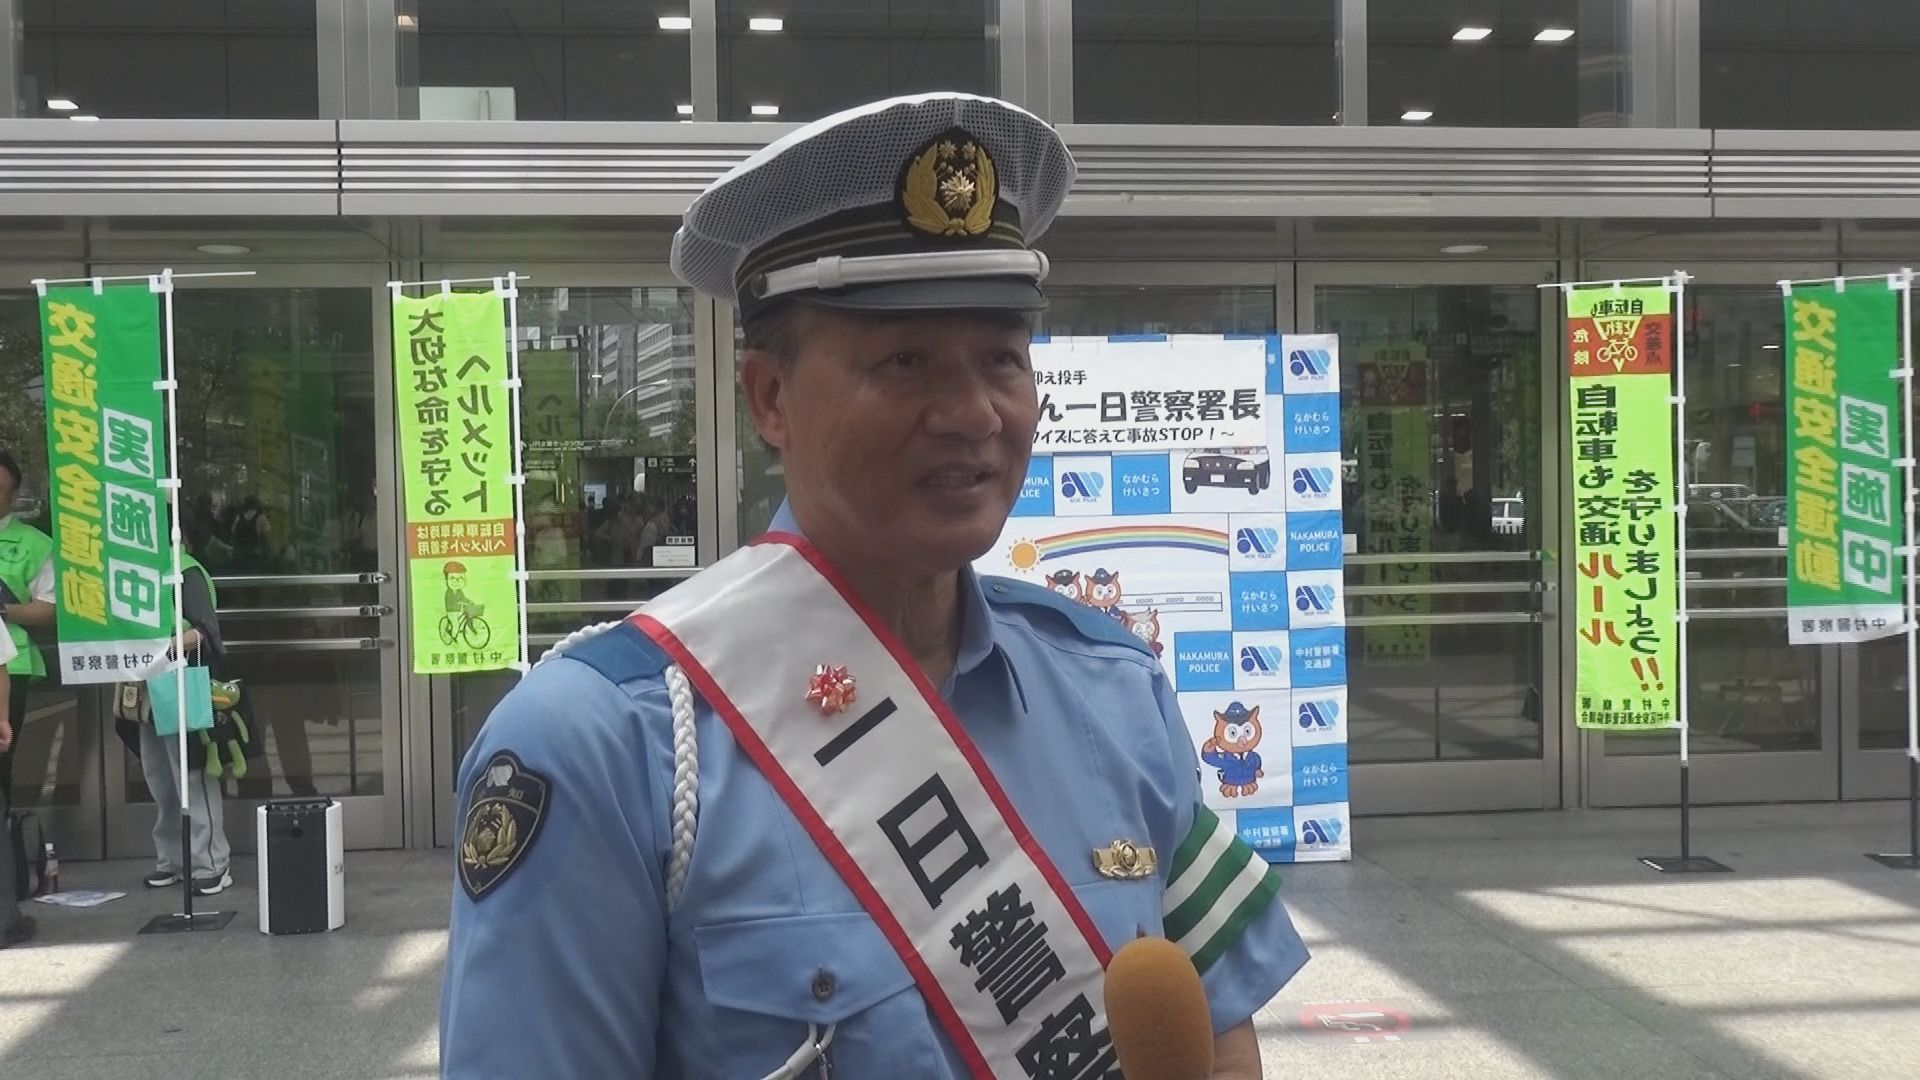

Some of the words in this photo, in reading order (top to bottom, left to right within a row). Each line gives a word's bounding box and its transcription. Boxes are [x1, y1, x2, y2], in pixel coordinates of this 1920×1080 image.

[1294, 411, 1329, 423] なかむら
[1294, 423, 1330, 434] けいさつ
[1123, 474, 1159, 484] なかむら
[1123, 487, 1160, 497] けいさつ
[1290, 530, 1338, 541] NAKAMURA
[1299, 542, 1330, 552] POLICE
[1241, 590, 1278, 601] なかむら
[1242, 603, 1279, 613] けいさつ
[1178, 652, 1230, 662] NAKAMURA
[1188, 663, 1221, 673] POLICE
